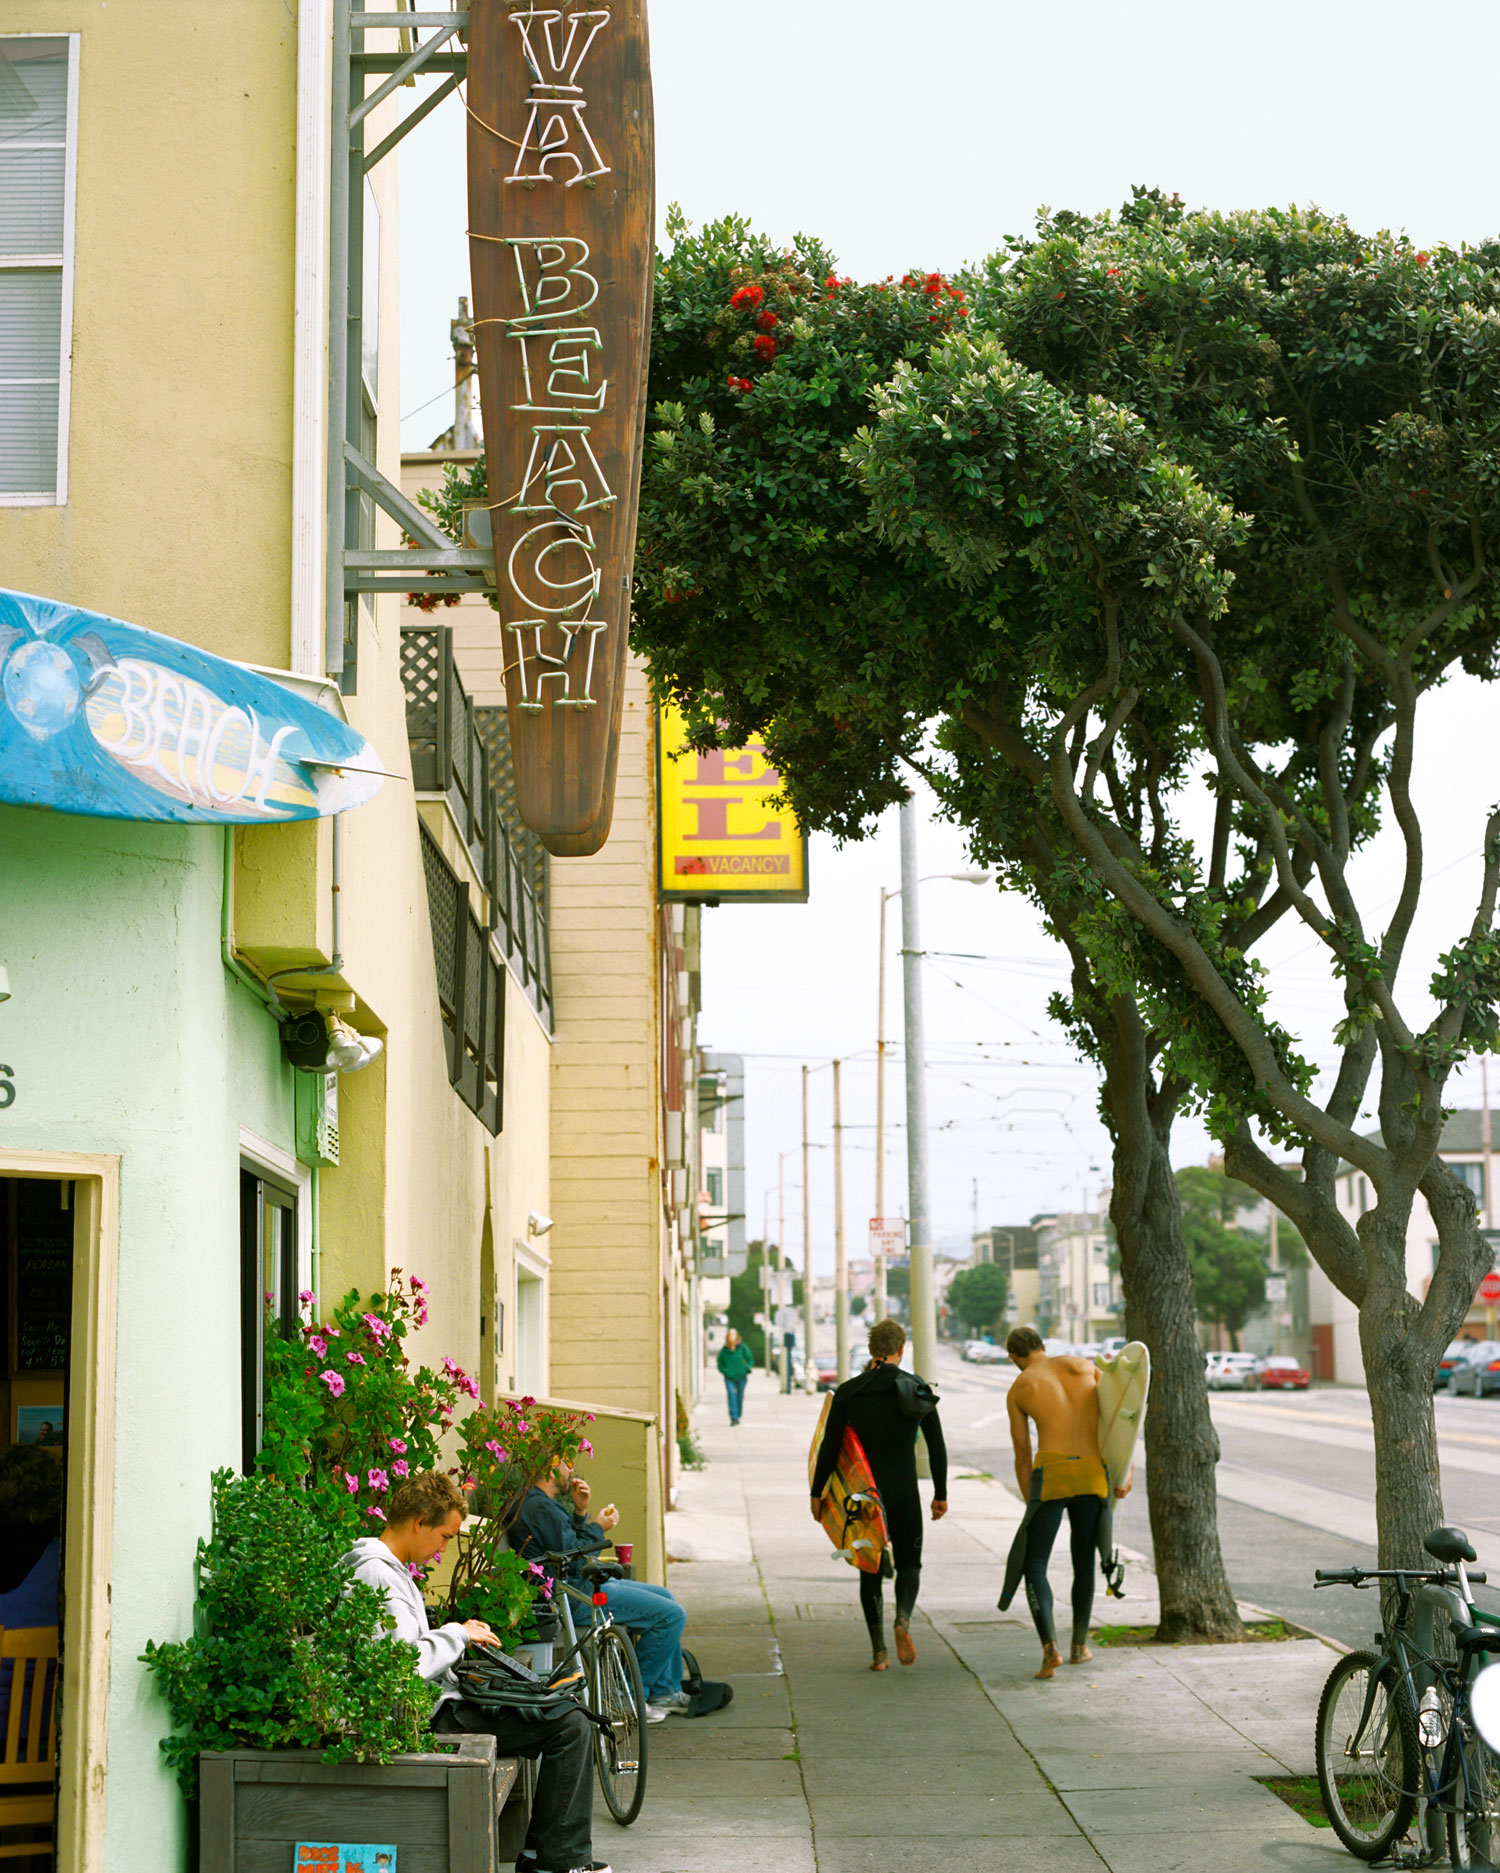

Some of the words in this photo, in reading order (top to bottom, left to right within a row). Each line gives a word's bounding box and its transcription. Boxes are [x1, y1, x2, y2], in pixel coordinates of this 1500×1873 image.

[504, 11, 611, 187] VA
[505, 237, 617, 709] BEACH
[90, 660, 298, 813] BEACH
[709, 856, 784, 873] VACANCY
[0, 1064, 16, 1109] 6
